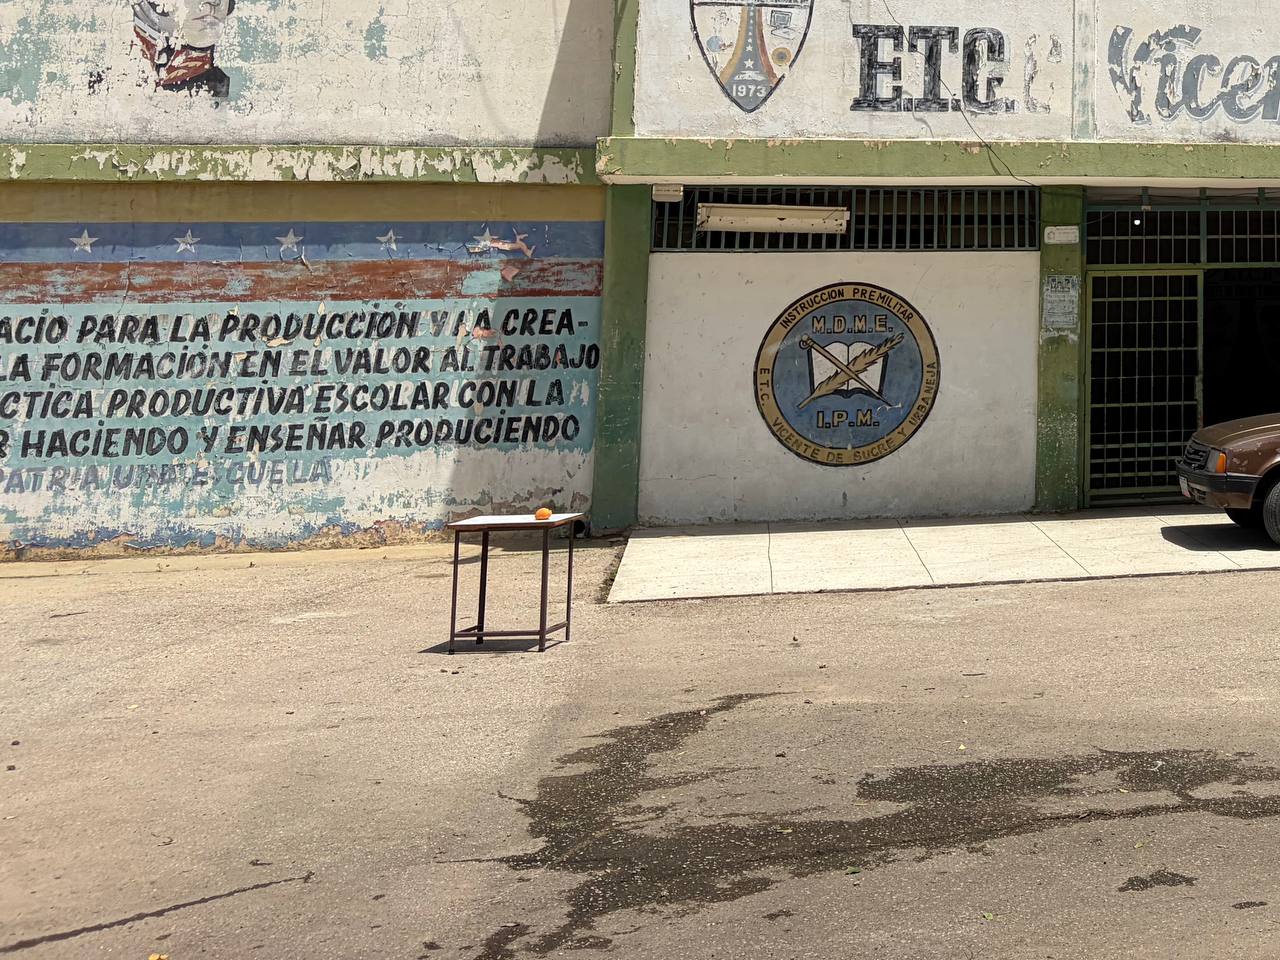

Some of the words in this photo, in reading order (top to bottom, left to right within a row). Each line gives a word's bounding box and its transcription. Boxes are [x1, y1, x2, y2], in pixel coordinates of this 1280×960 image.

[732, 84, 767, 97] 1973
[780, 288, 845, 329] INSTRUCCION
[852, 287, 914, 323] PREMILITAR
[811, 314, 894, 335] M.D.M.E.
[76, 314, 160, 344] PARA
[169, 315, 211, 343] LA
[430, 311, 449, 337] Y
[240, 349, 282, 378] EN
[289, 348, 328, 377] EL
[334, 345, 431, 375] VALOR
[439, 344, 475, 373] AL
[483, 342, 600, 371] TRABAJO
[106, 379, 305, 419] PRODUCTIVA
[313, 380, 449, 414] ESCOLAR
[458, 380, 517, 410] CON
[525, 378, 565, 407] LA
[772, 416, 821, 459] VICENTE
[827, 451, 844, 464] DE
[853, 437, 894, 461] SUCRE
[897, 427, 908, 437] Y
[908, 361, 937, 426] URBANEJA
[21, 419, 189, 459] HACIENDO
[197, 425, 219, 453] Y
[224, 415, 367, 454] ENSEÑAR
[375, 409, 581, 449] PRODUCIENDO
[816, 409, 880, 428] I.P.M.
